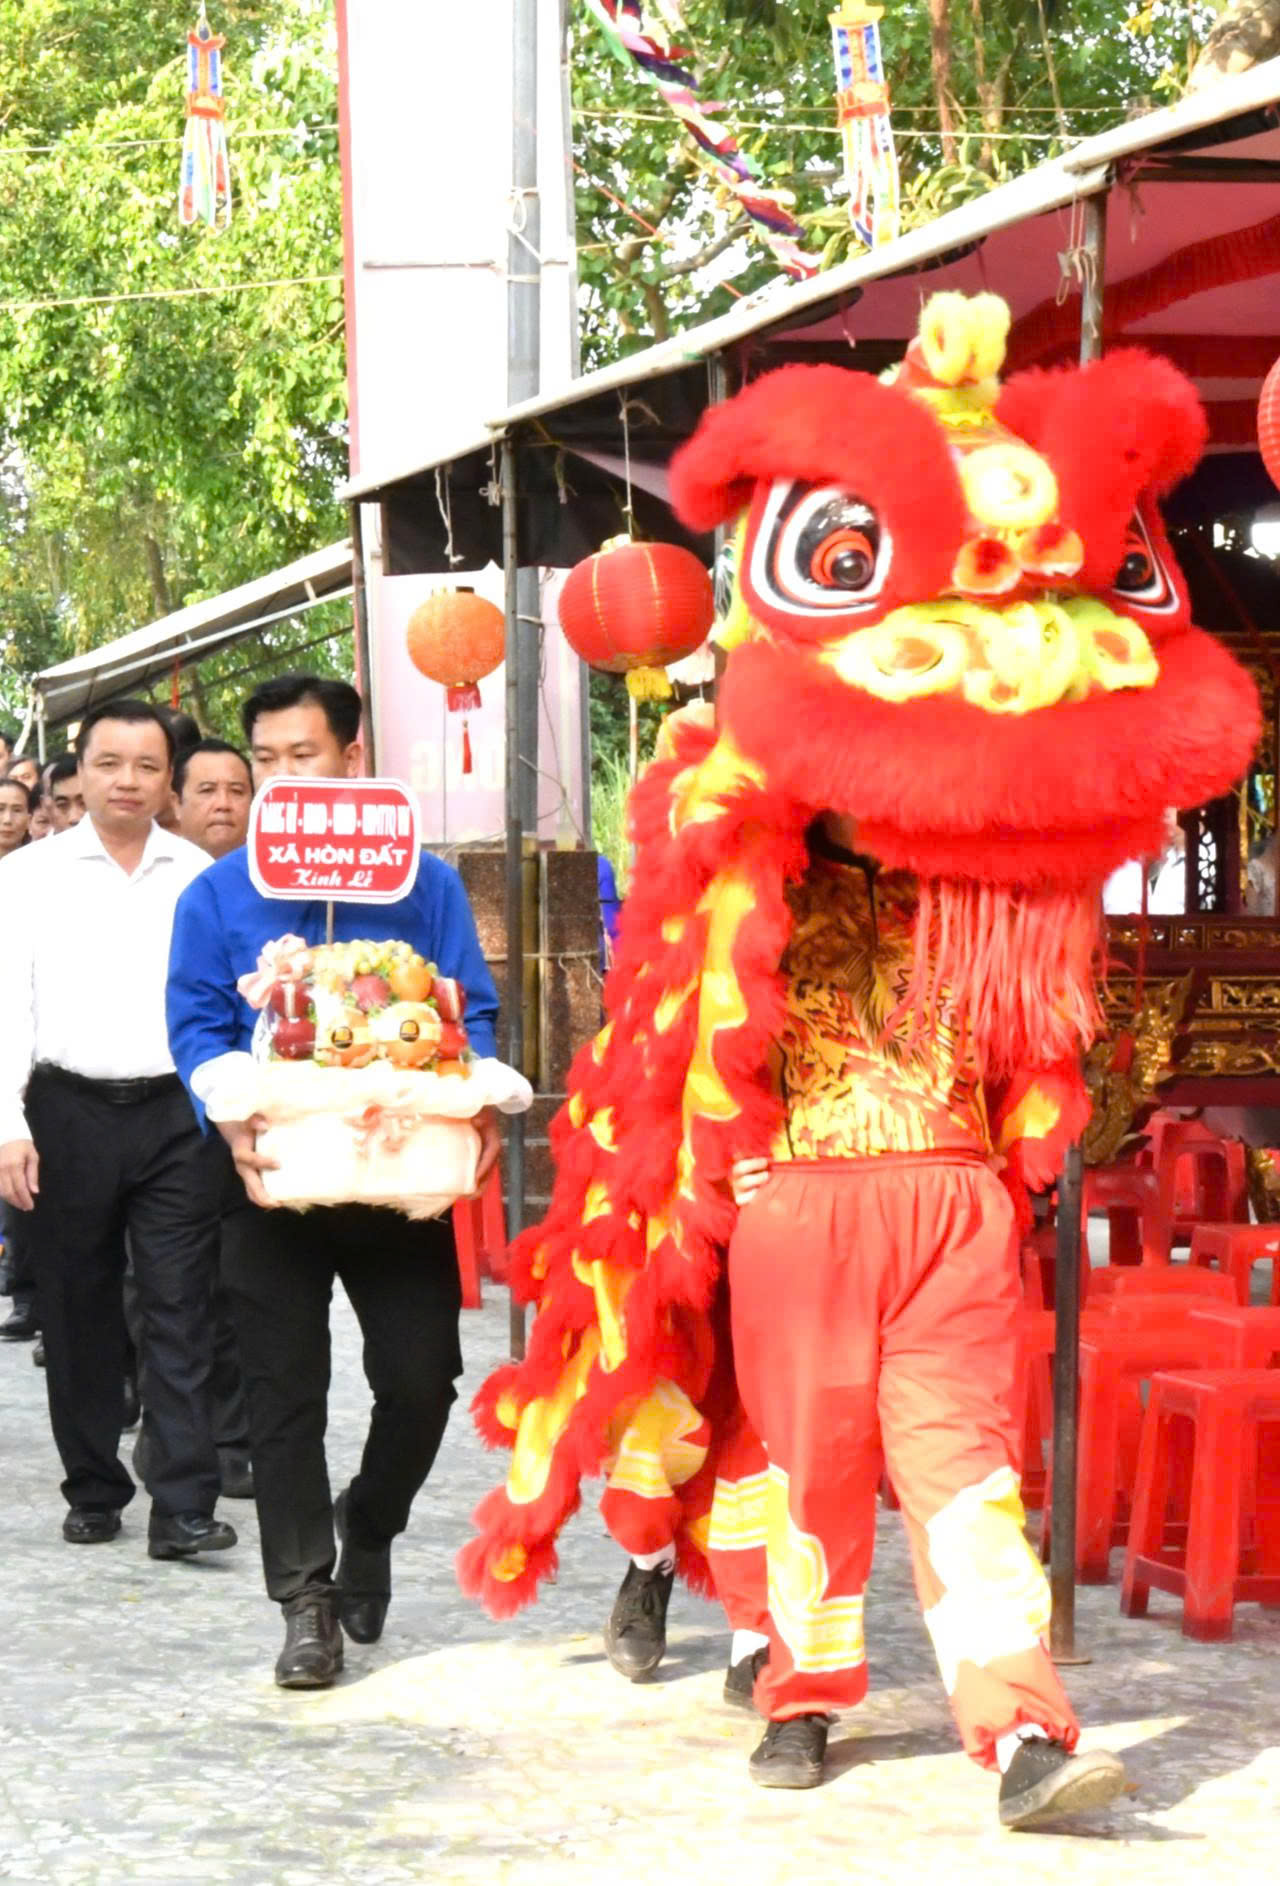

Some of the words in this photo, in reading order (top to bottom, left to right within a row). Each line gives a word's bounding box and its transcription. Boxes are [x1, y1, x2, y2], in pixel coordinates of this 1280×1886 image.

[268, 842, 300, 864] XÃ
[304, 844, 354, 865] HÒN
[359, 842, 407, 866] ĐẤT
